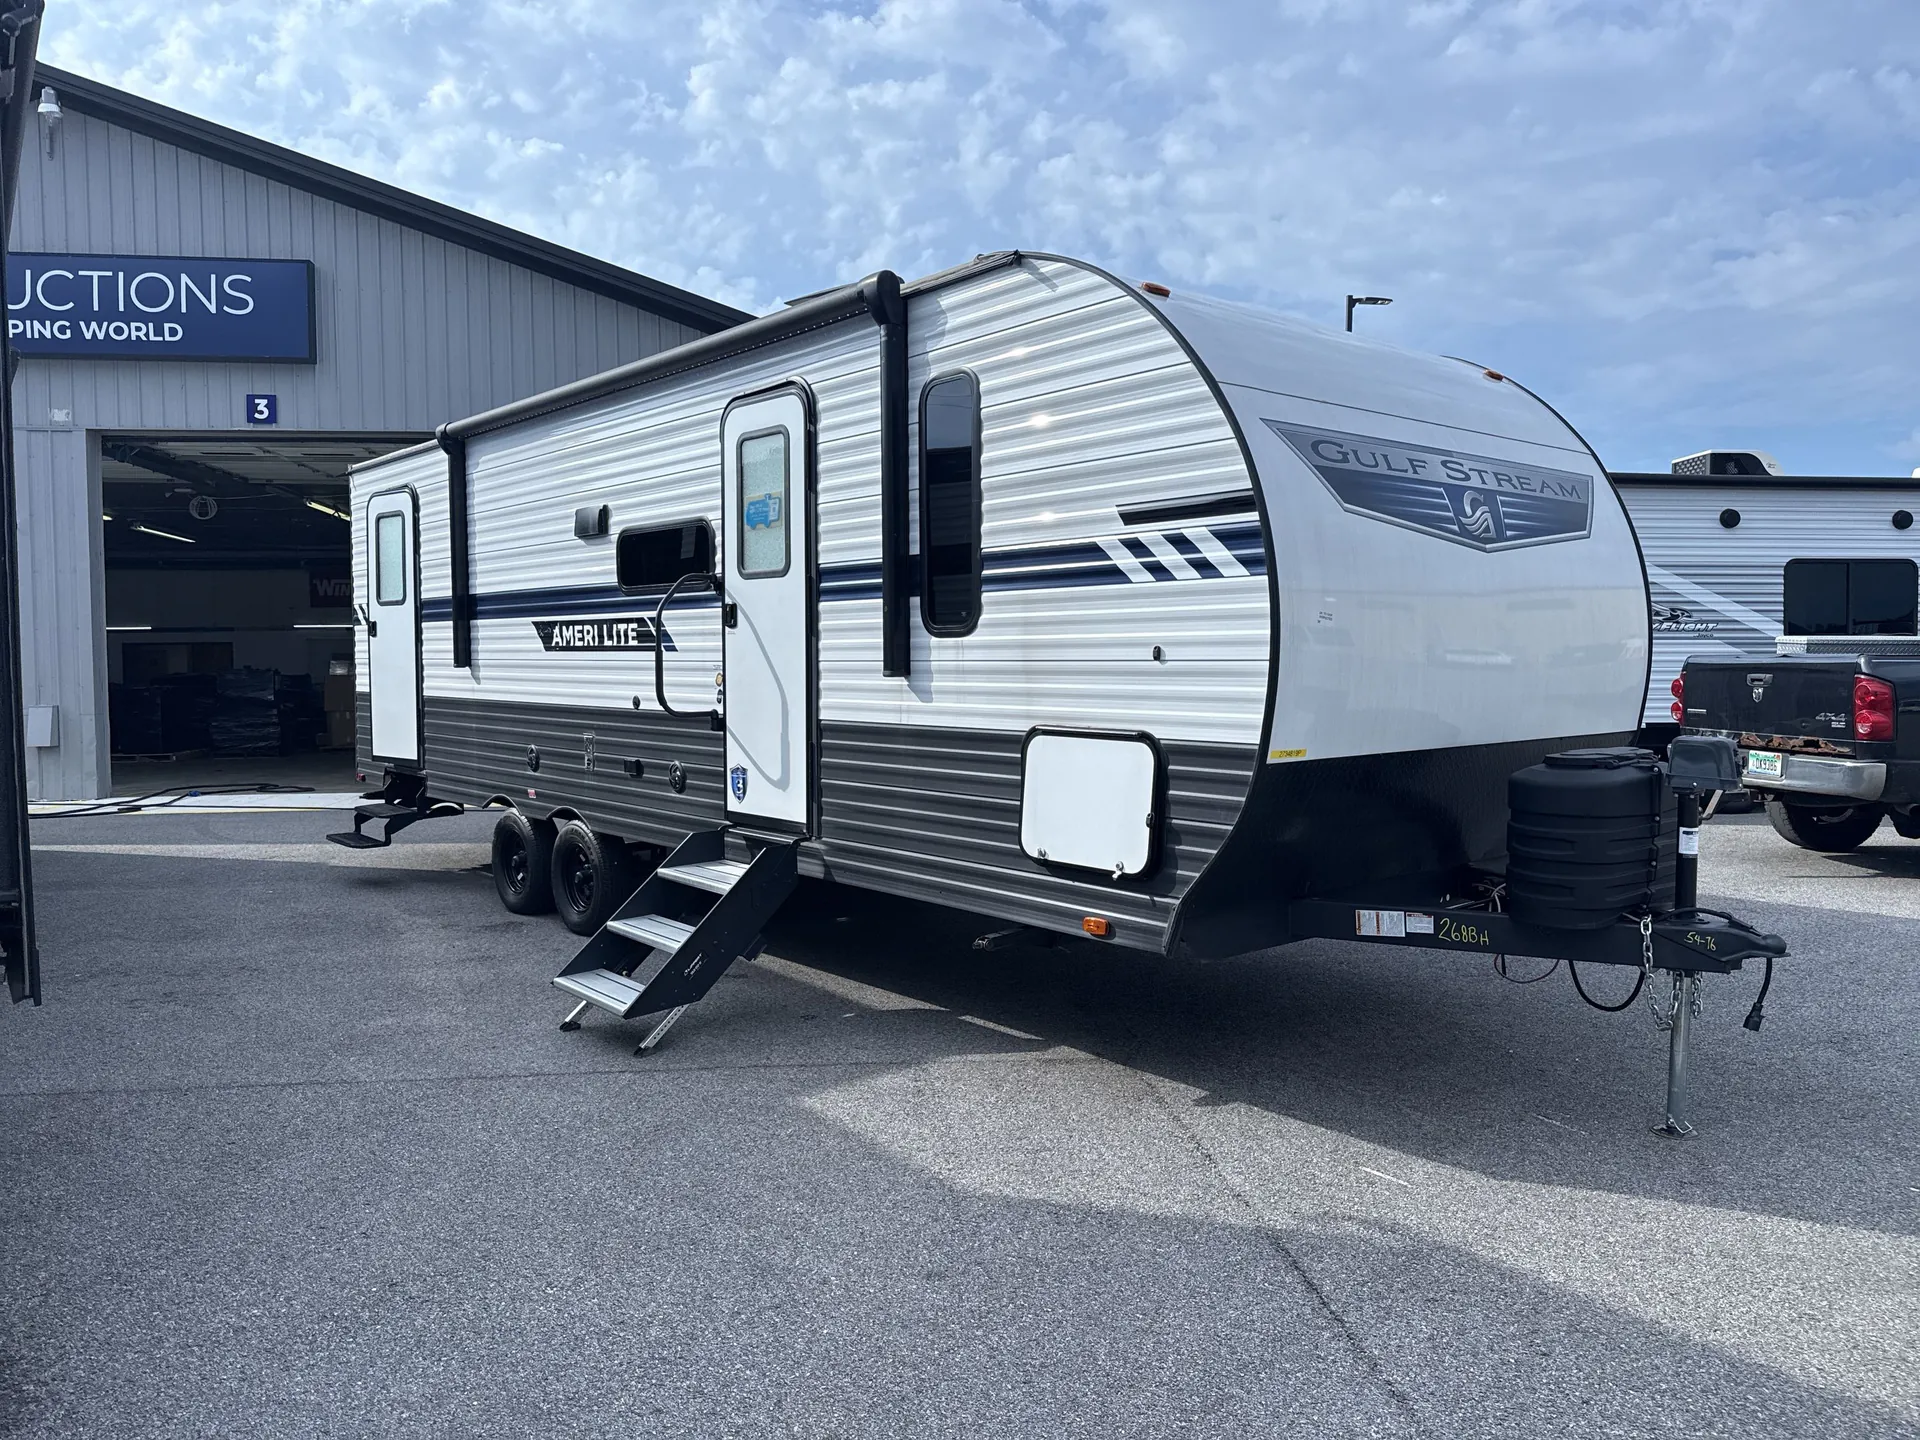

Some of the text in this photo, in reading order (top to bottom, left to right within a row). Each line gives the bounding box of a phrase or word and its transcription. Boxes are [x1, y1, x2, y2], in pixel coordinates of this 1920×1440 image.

[8, 319, 184, 342] PING WORLD
[253, 398, 270, 420] 3
[1310, 439, 1583, 500] GULF STREAM
[551, 623, 639, 647] AMERI LITE
[1438, 917, 1490, 946] 268BH
